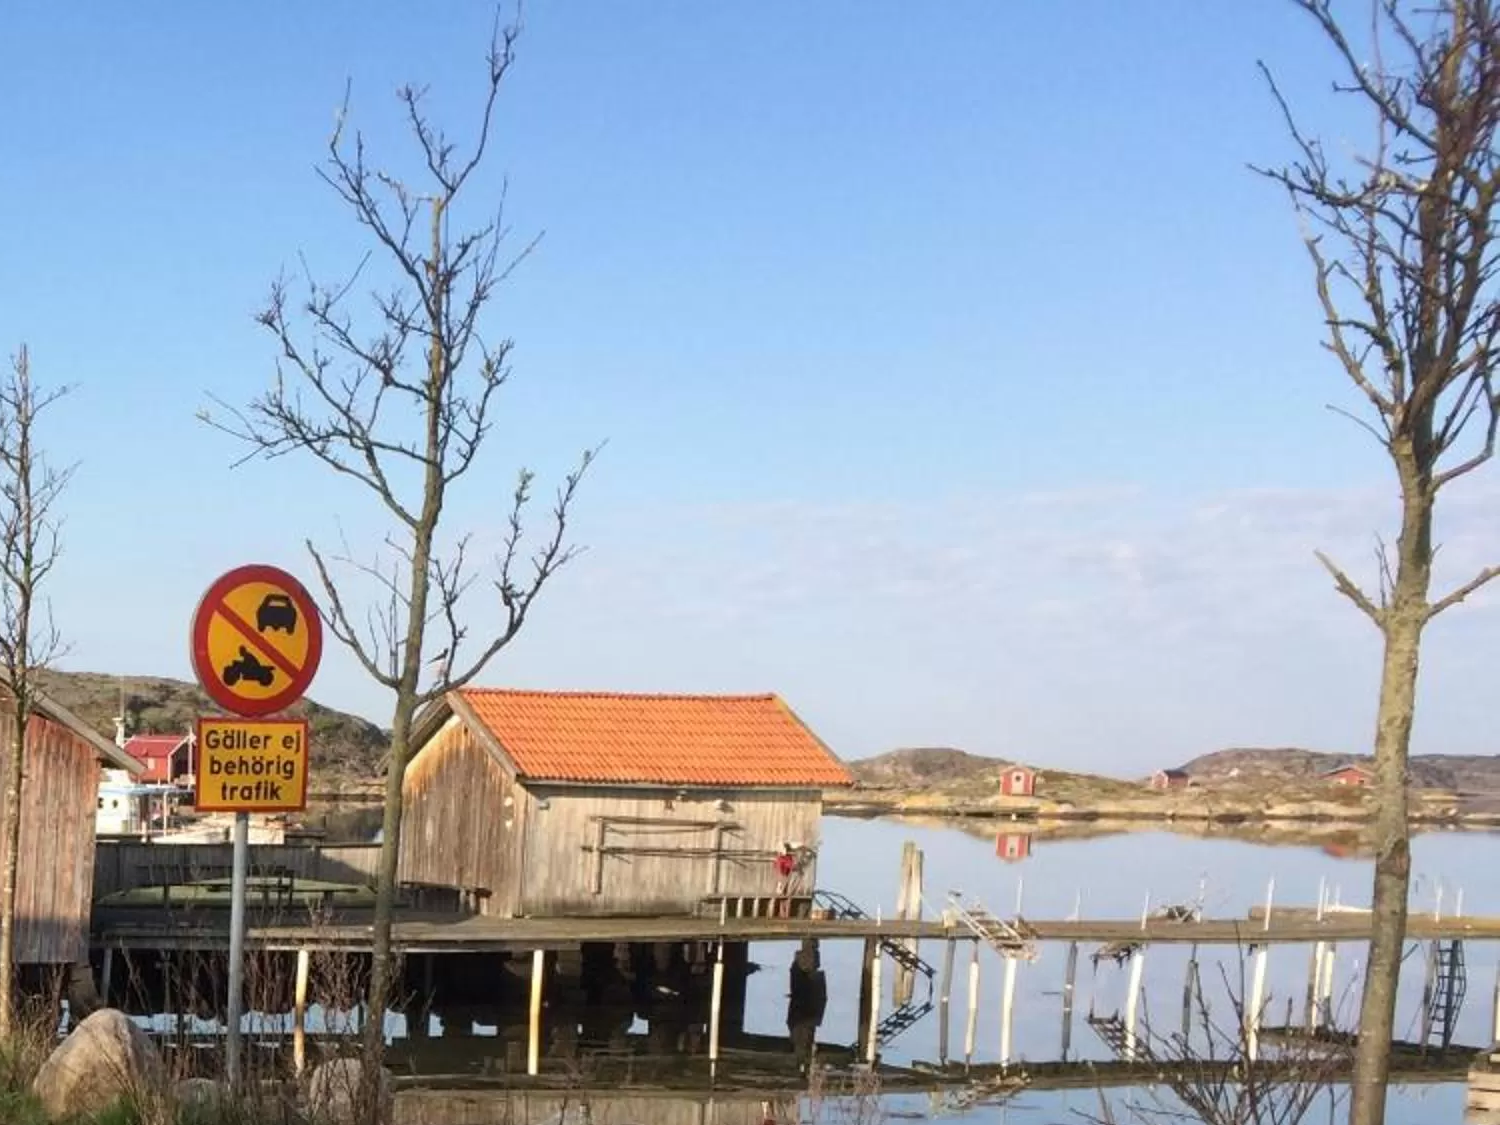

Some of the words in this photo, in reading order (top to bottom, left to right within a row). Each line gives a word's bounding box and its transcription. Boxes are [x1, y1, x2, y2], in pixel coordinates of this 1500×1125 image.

[205, 730, 272, 750] Gäller
[282, 730, 301, 753] ej
[209, 756, 295, 780] behörig
[221, 781, 283, 801] trafik
